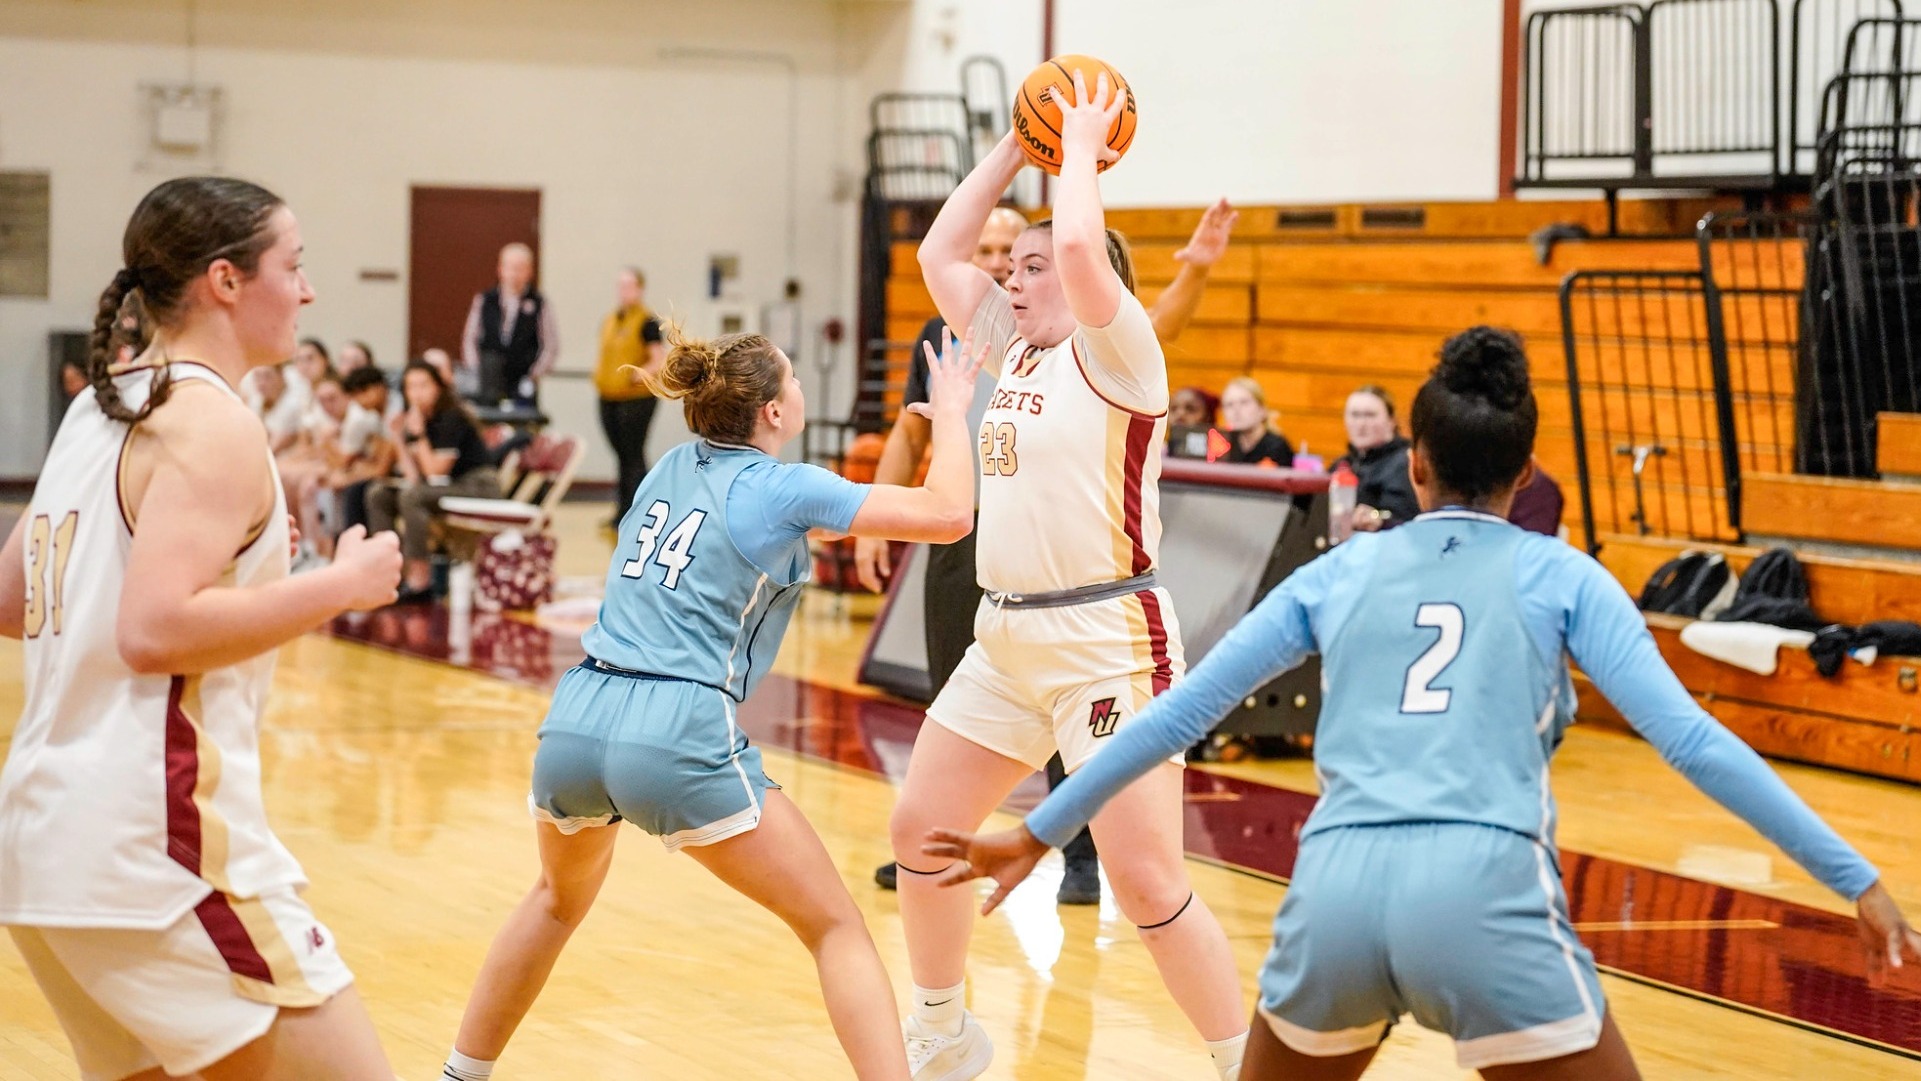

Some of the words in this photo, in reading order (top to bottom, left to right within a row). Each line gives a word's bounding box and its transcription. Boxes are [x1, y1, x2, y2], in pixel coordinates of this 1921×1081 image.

[980, 421, 1018, 477] 23
[24, 510, 80, 639] 31
[620, 498, 709, 592] 34
[1399, 601, 1466, 715] 2
[1088, 696, 1121, 738] NU
